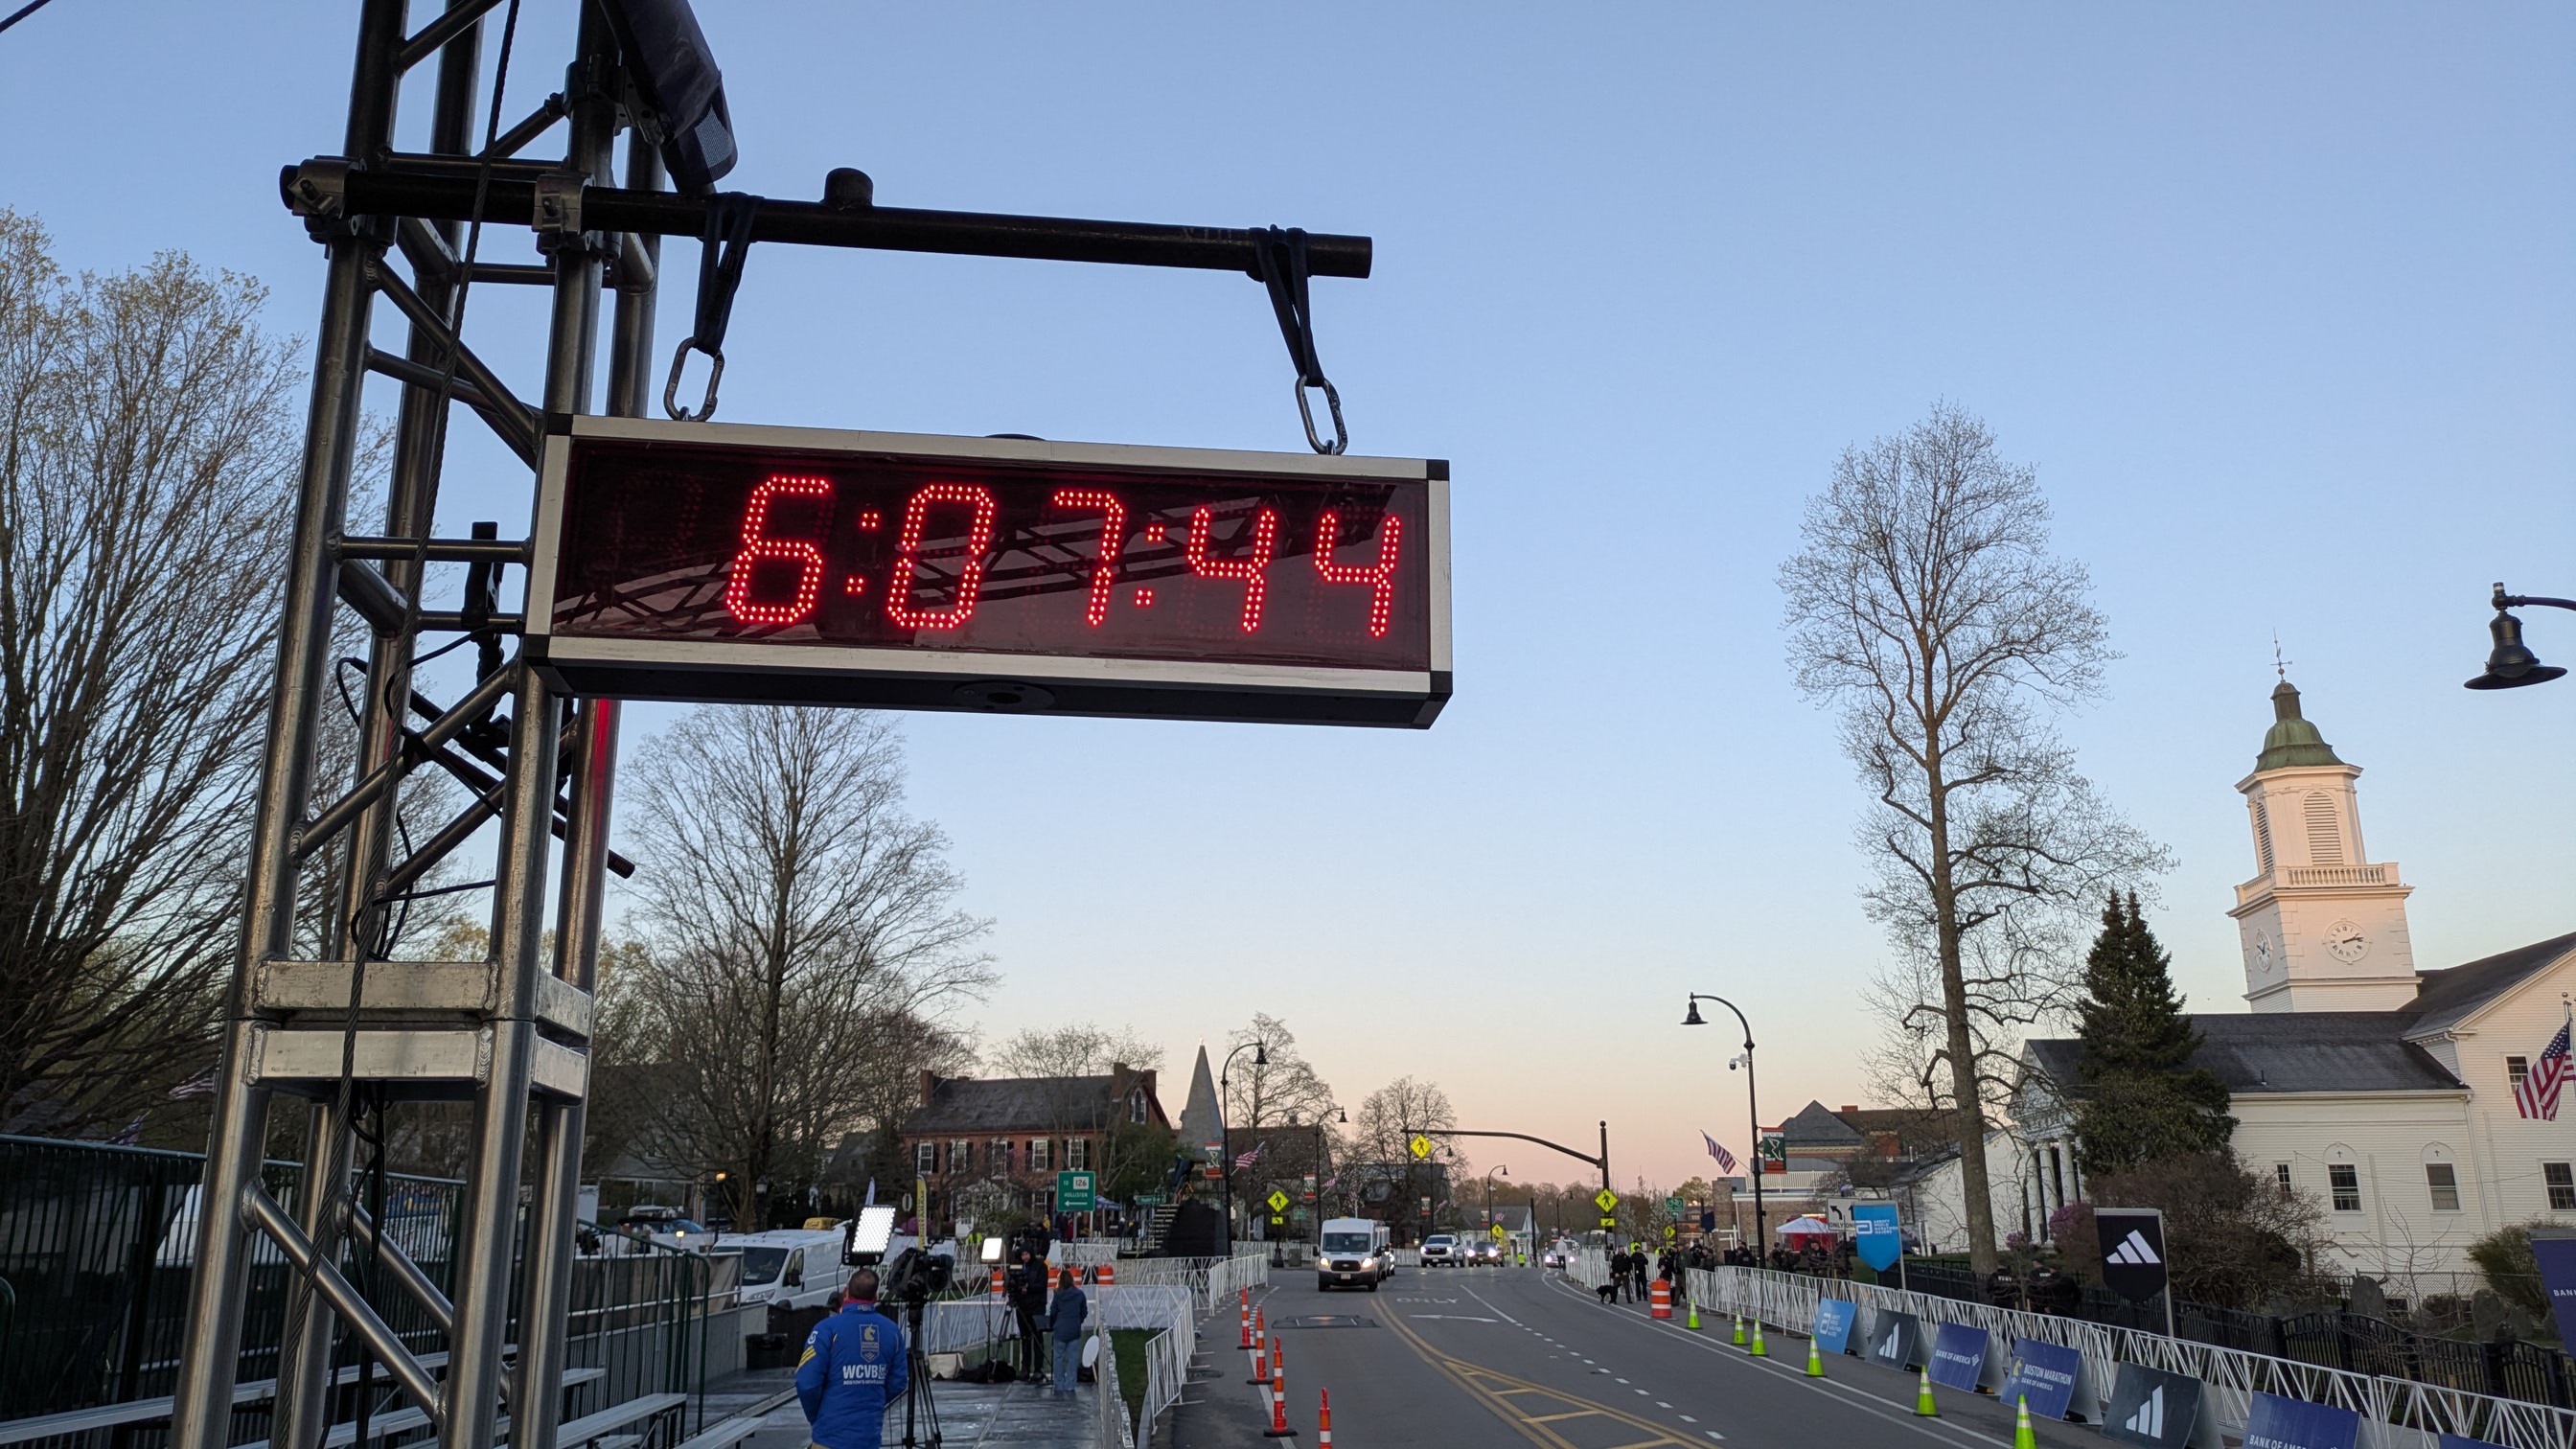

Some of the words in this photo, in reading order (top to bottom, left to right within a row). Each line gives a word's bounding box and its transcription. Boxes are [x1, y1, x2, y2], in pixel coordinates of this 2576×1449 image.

[725, 475, 1400, 638] 6:07:44
[1936, 1349, 1948, 1359] BANK
[1953, 1354, 1971, 1365] AMERICA
[2024, 1364, 2045, 1378] BOSTON
[2044, 1369, 2072, 1385] MARATHON
[2021, 1377, 2032, 1386] BANK
[2036, 1381, 2053, 1391] AMERICA
[2249, 1435, 2271, 1448] BANK
[2271, 1440, 2282, 1449] OF
